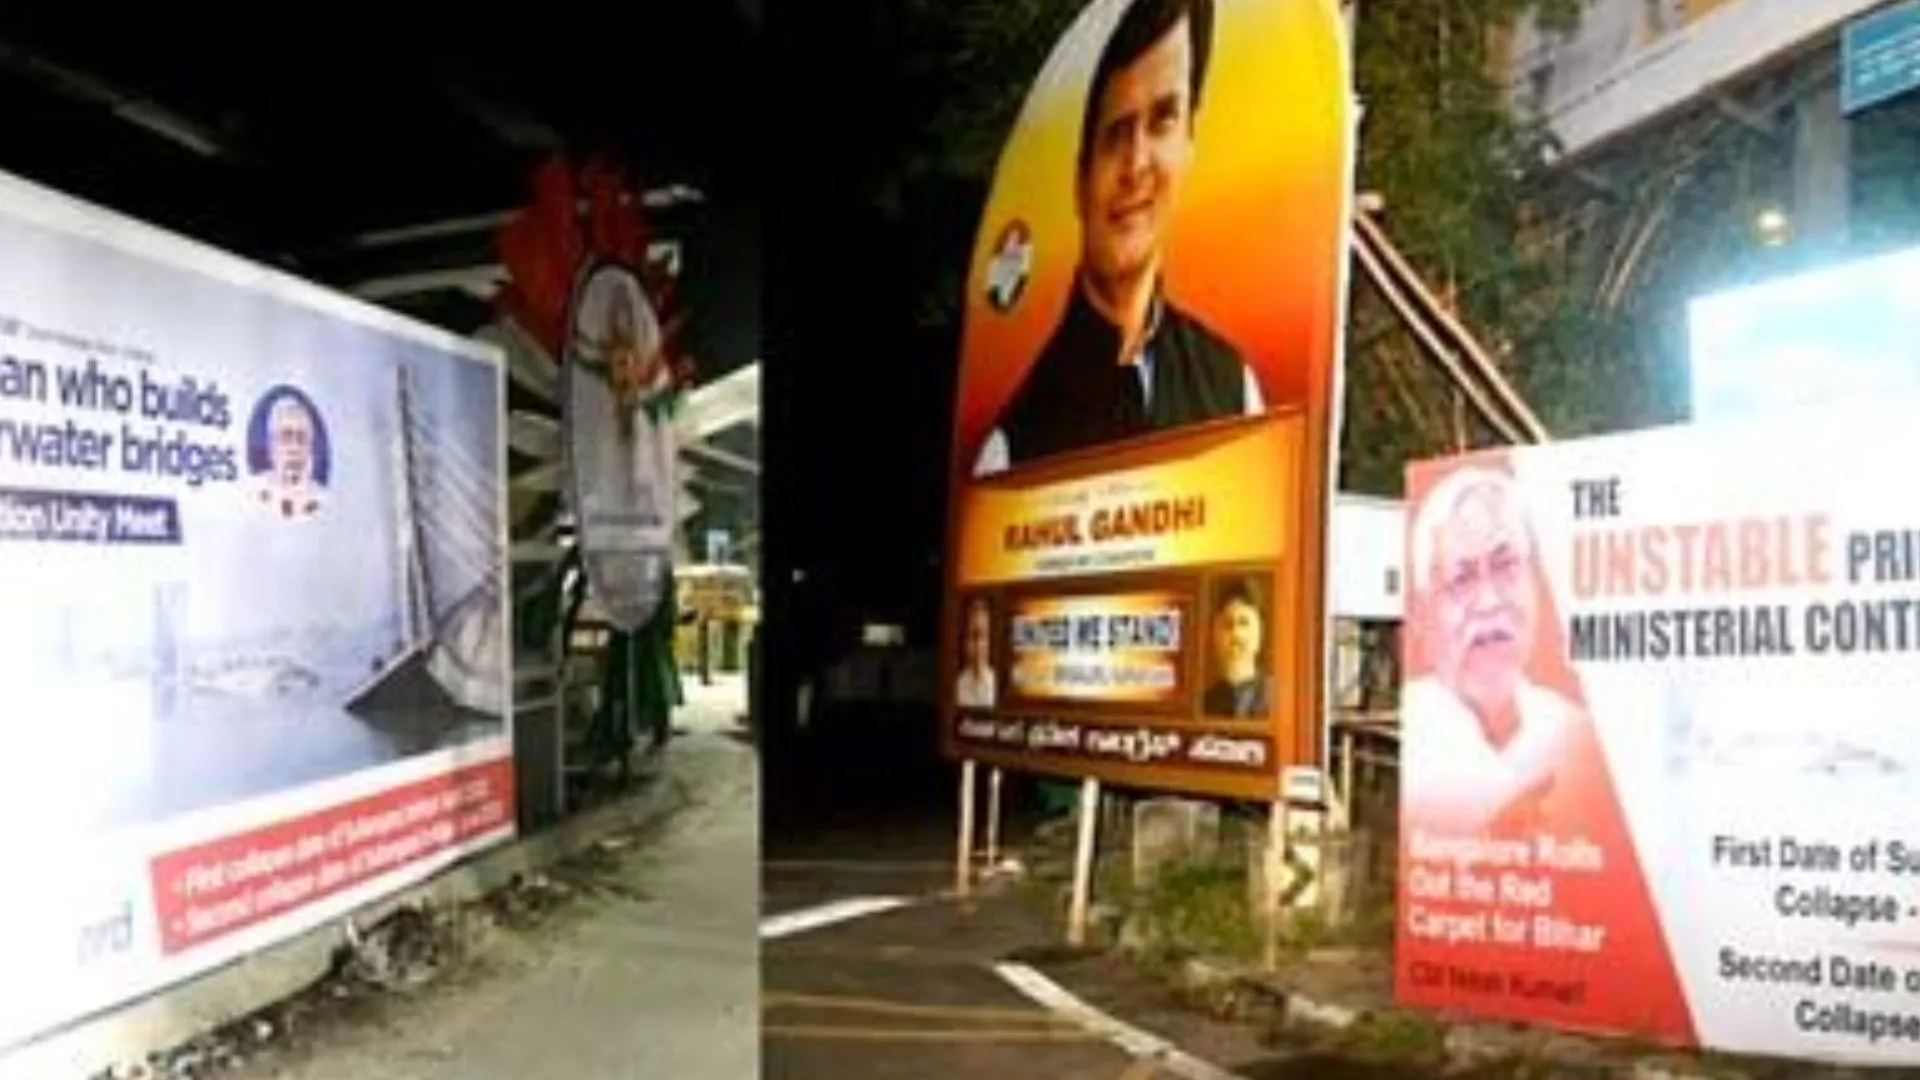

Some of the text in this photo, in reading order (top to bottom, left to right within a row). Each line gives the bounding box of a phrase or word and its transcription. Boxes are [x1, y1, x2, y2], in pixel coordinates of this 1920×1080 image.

[57, 359, 131, 415] who
[141, 370, 229, 428] builds
[121, 425, 238, 487] bridges
[1090, 493, 1205, 544] GANDHI
[1570, 477, 1621, 519] THE
[1571, 514, 1920, 600] UNSTABLE PRI
[1569, 599, 1920, 661] MINISTERIAL CONT
[1713, 834, 1772, 867] First
[1779, 838, 1840, 871] Date
[1850, 838, 1877, 872] of
[1409, 866, 1449, 897] Out
[1499, 873, 1551, 907] Red
[1775, 884, 1898, 928] Collapse
[1408, 904, 1605, 952] Carpet for Bihar
[1719, 948, 1821, 986] Second
[1830, 956, 1895, 991] Date
